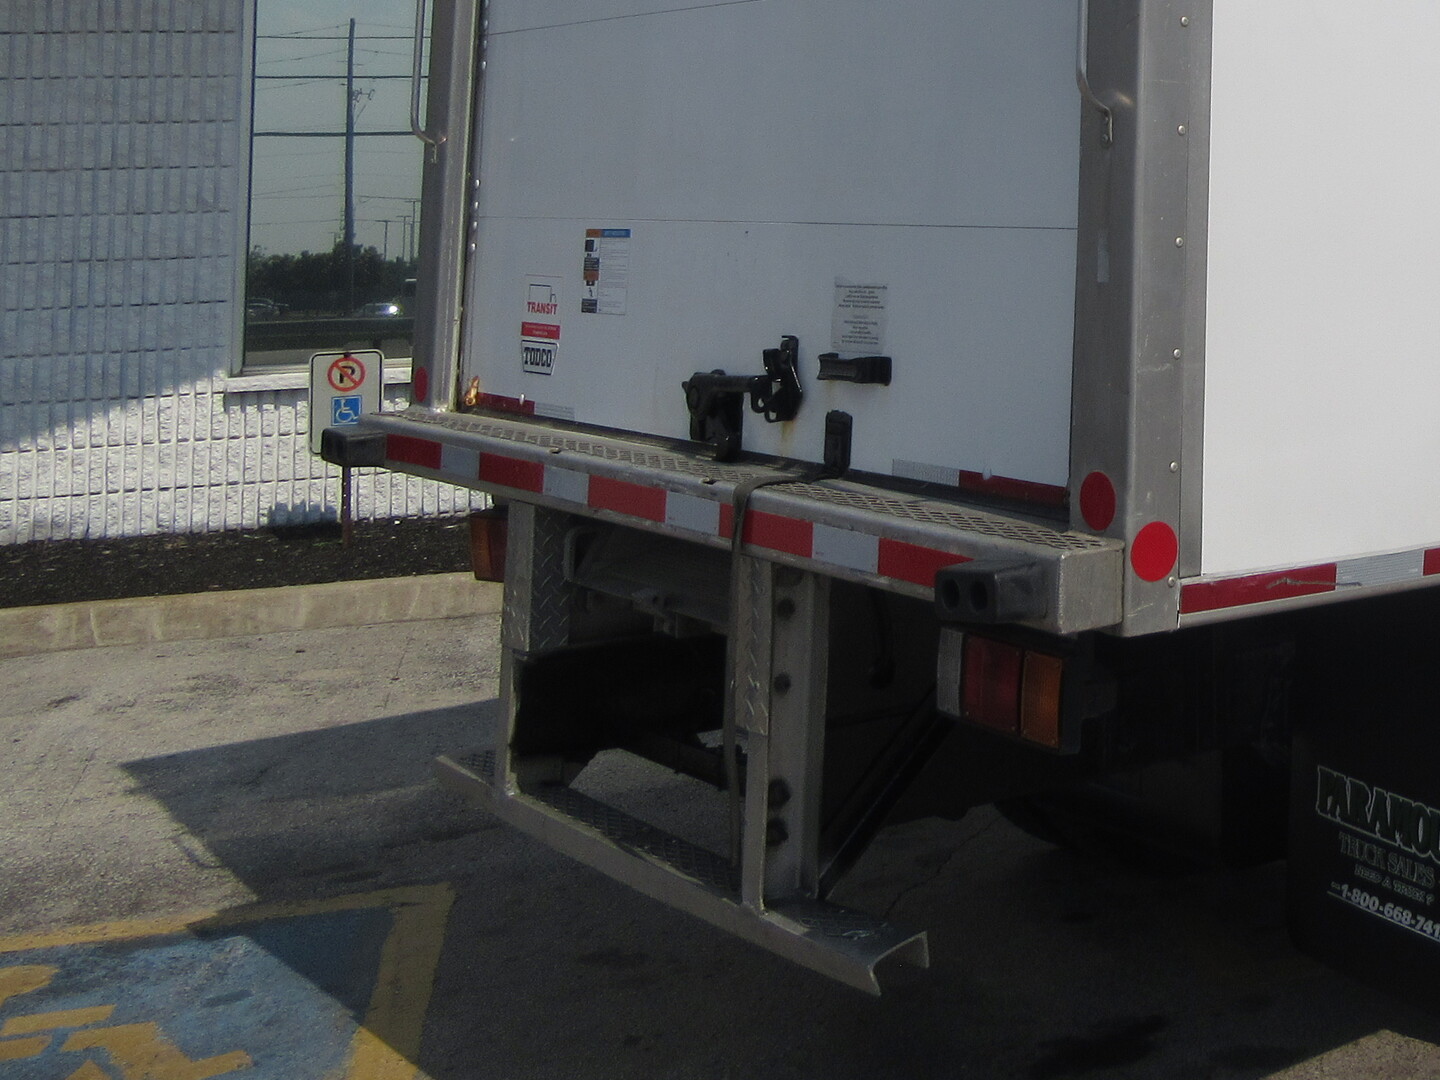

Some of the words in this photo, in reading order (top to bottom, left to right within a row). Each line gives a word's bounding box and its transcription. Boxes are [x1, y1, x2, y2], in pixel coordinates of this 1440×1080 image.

[526, 301, 558, 316] TRANSIT
[523, 347, 553, 368] TODCO
[1338, 831, 1387, 871] TRUCK
[1387, 852, 1436, 890] SALES
